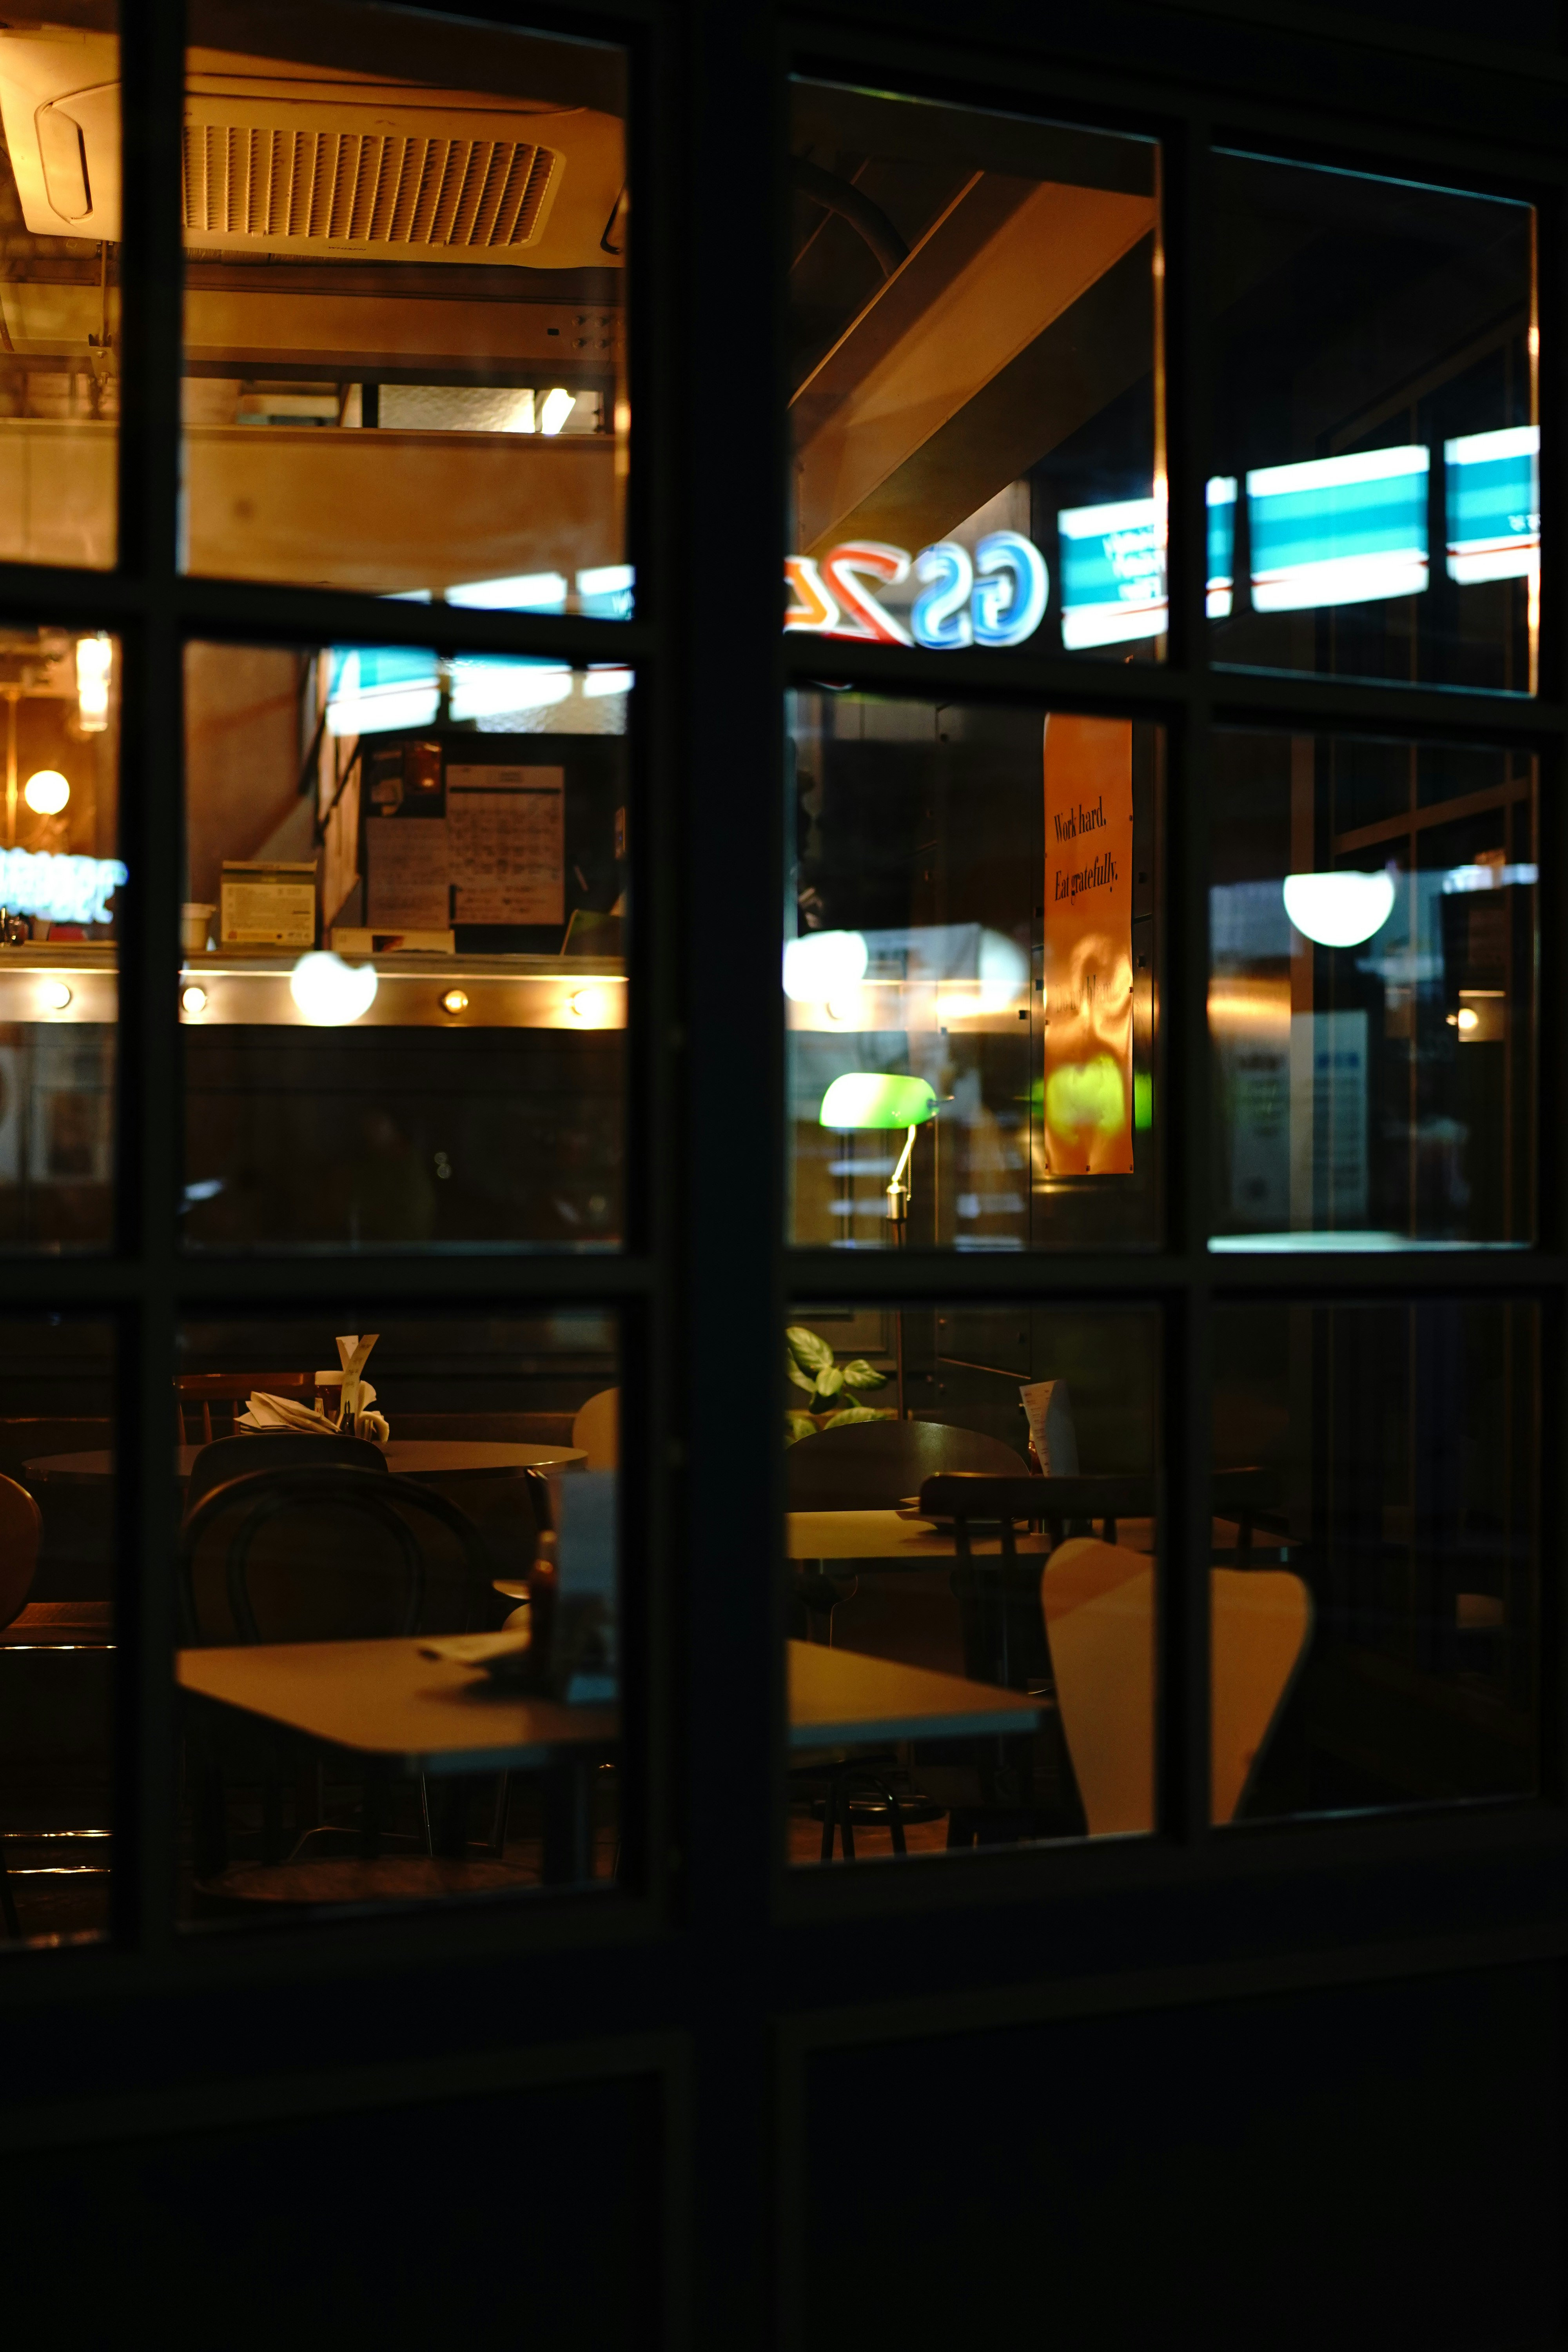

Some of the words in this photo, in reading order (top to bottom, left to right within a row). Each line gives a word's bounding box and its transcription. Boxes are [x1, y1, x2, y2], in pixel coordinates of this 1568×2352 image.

[1054, 808, 1076, 843] Work
[1054, 870, 1069, 901] Eat
[1071, 852, 1118, 905] gratefully.
